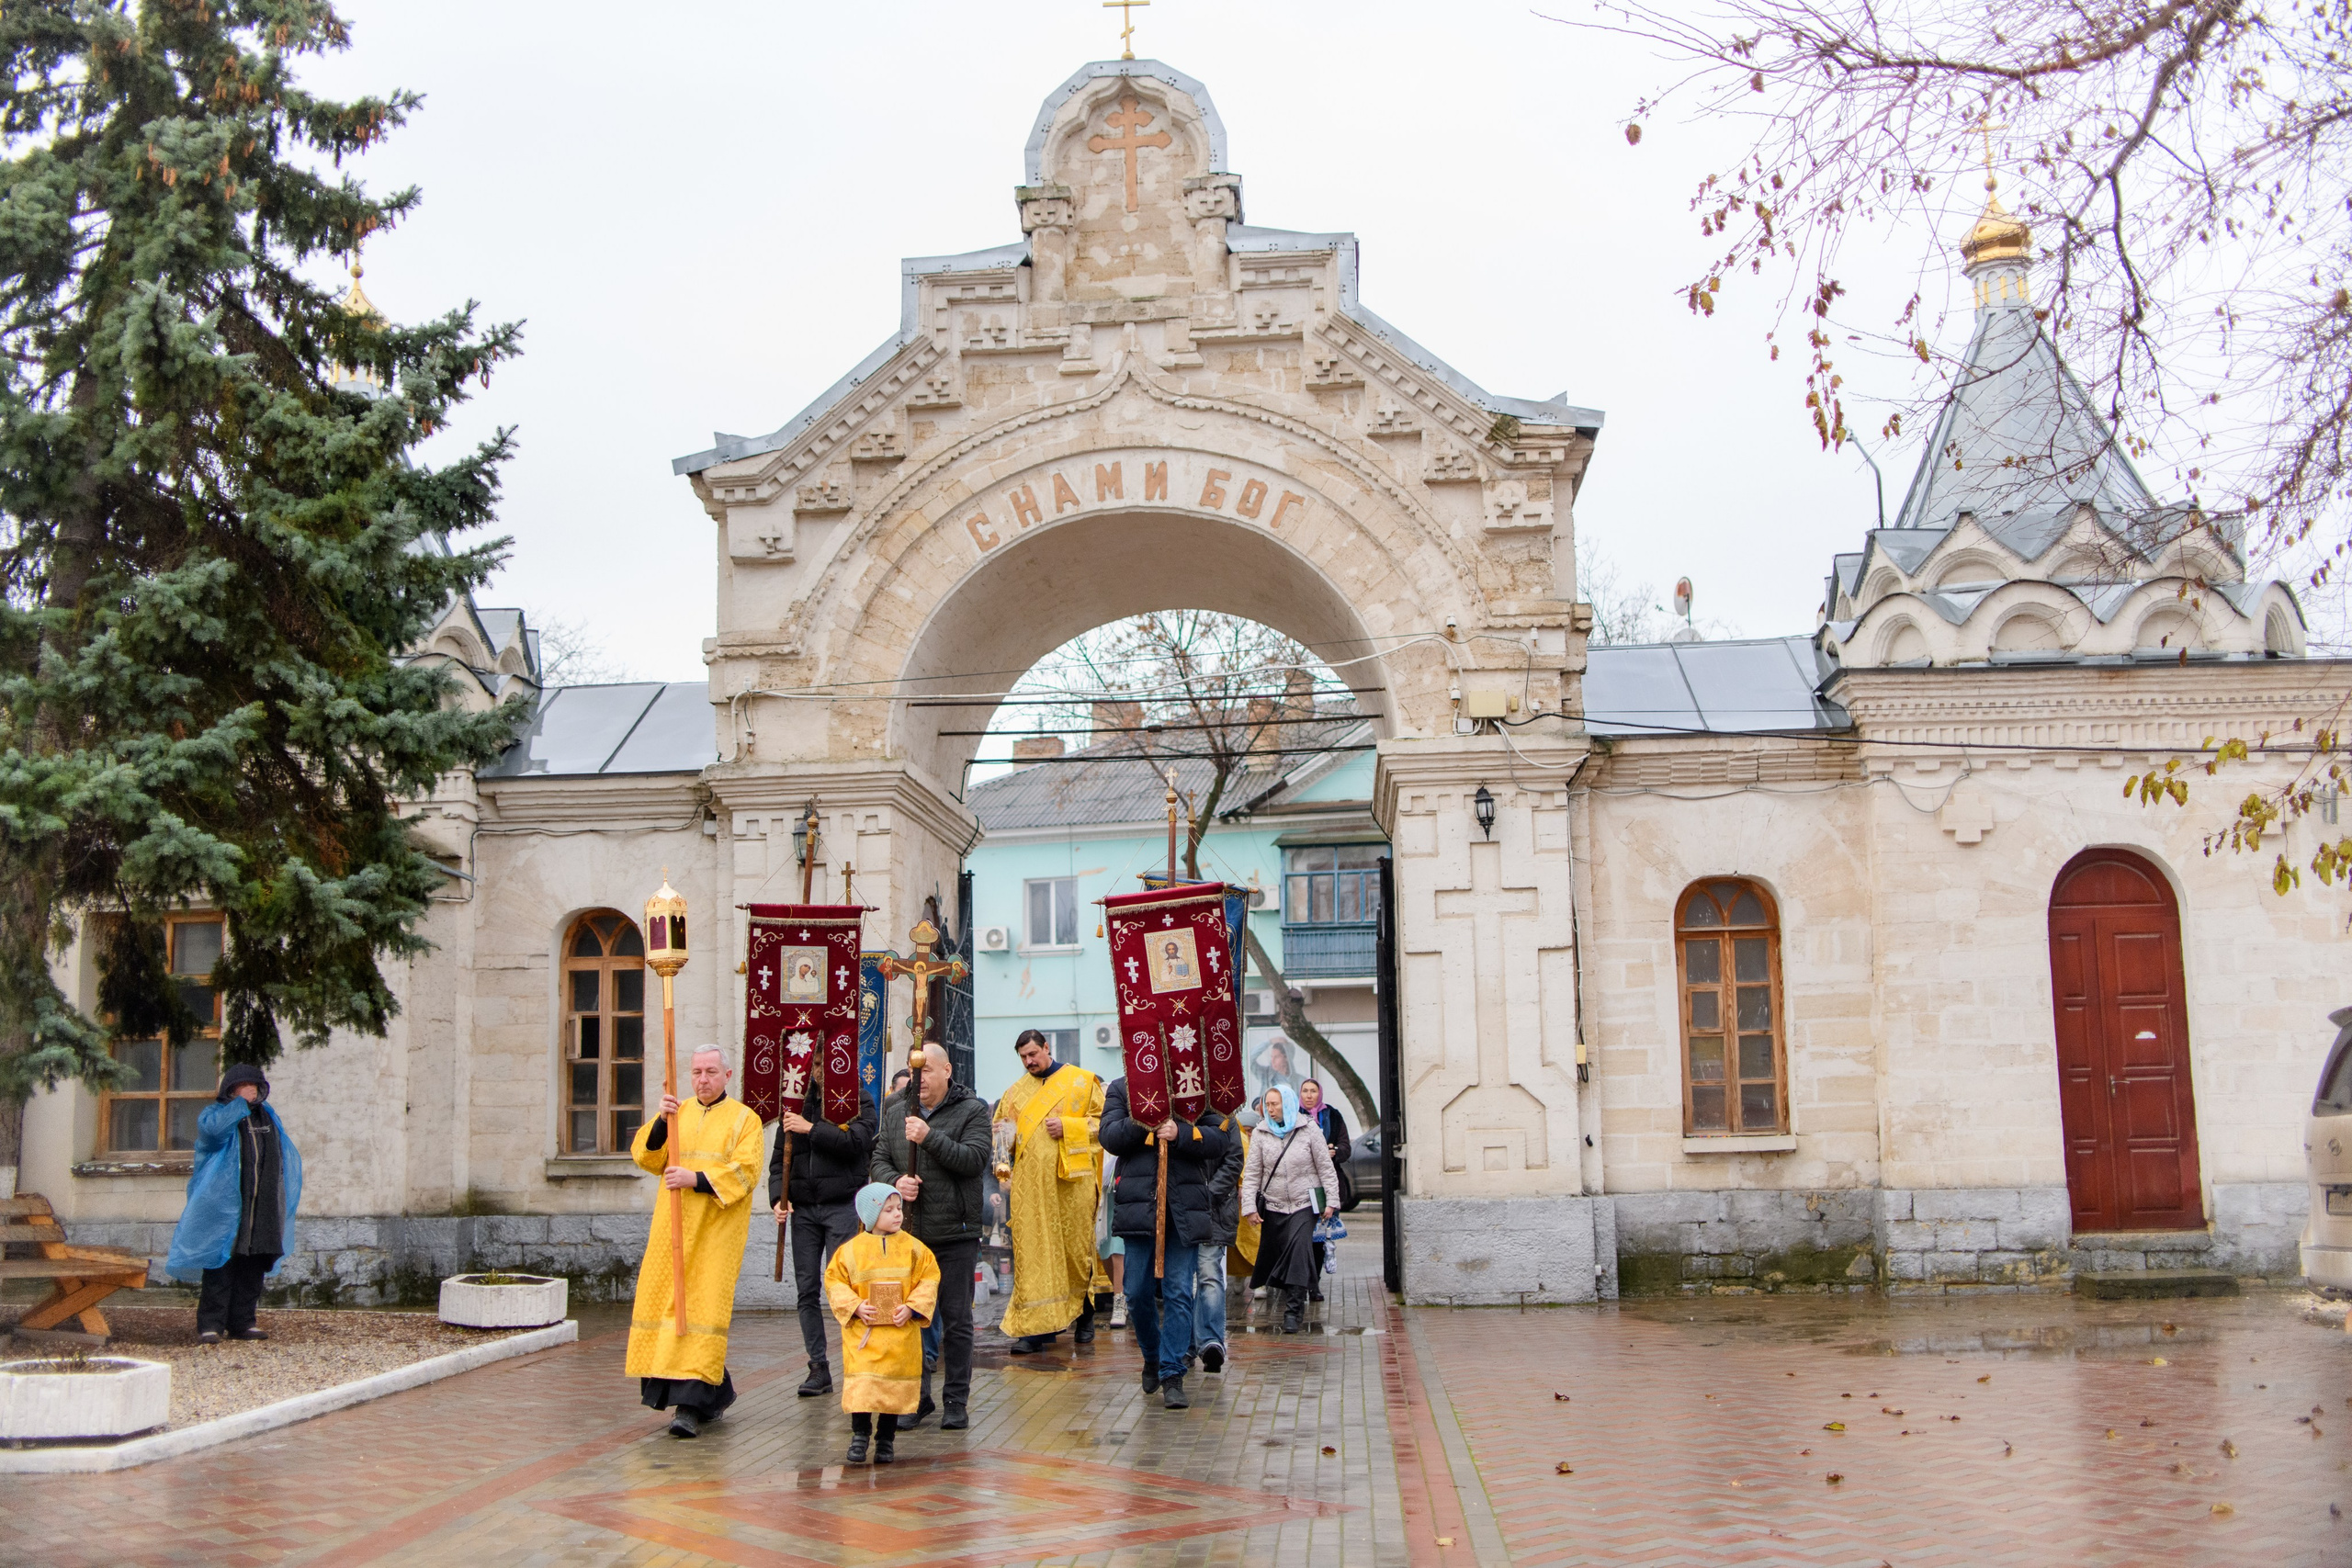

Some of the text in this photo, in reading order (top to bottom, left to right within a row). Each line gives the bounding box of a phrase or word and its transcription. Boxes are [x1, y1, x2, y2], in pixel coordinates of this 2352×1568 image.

[966, 461, 1305, 552] С НАМИ БОГ
